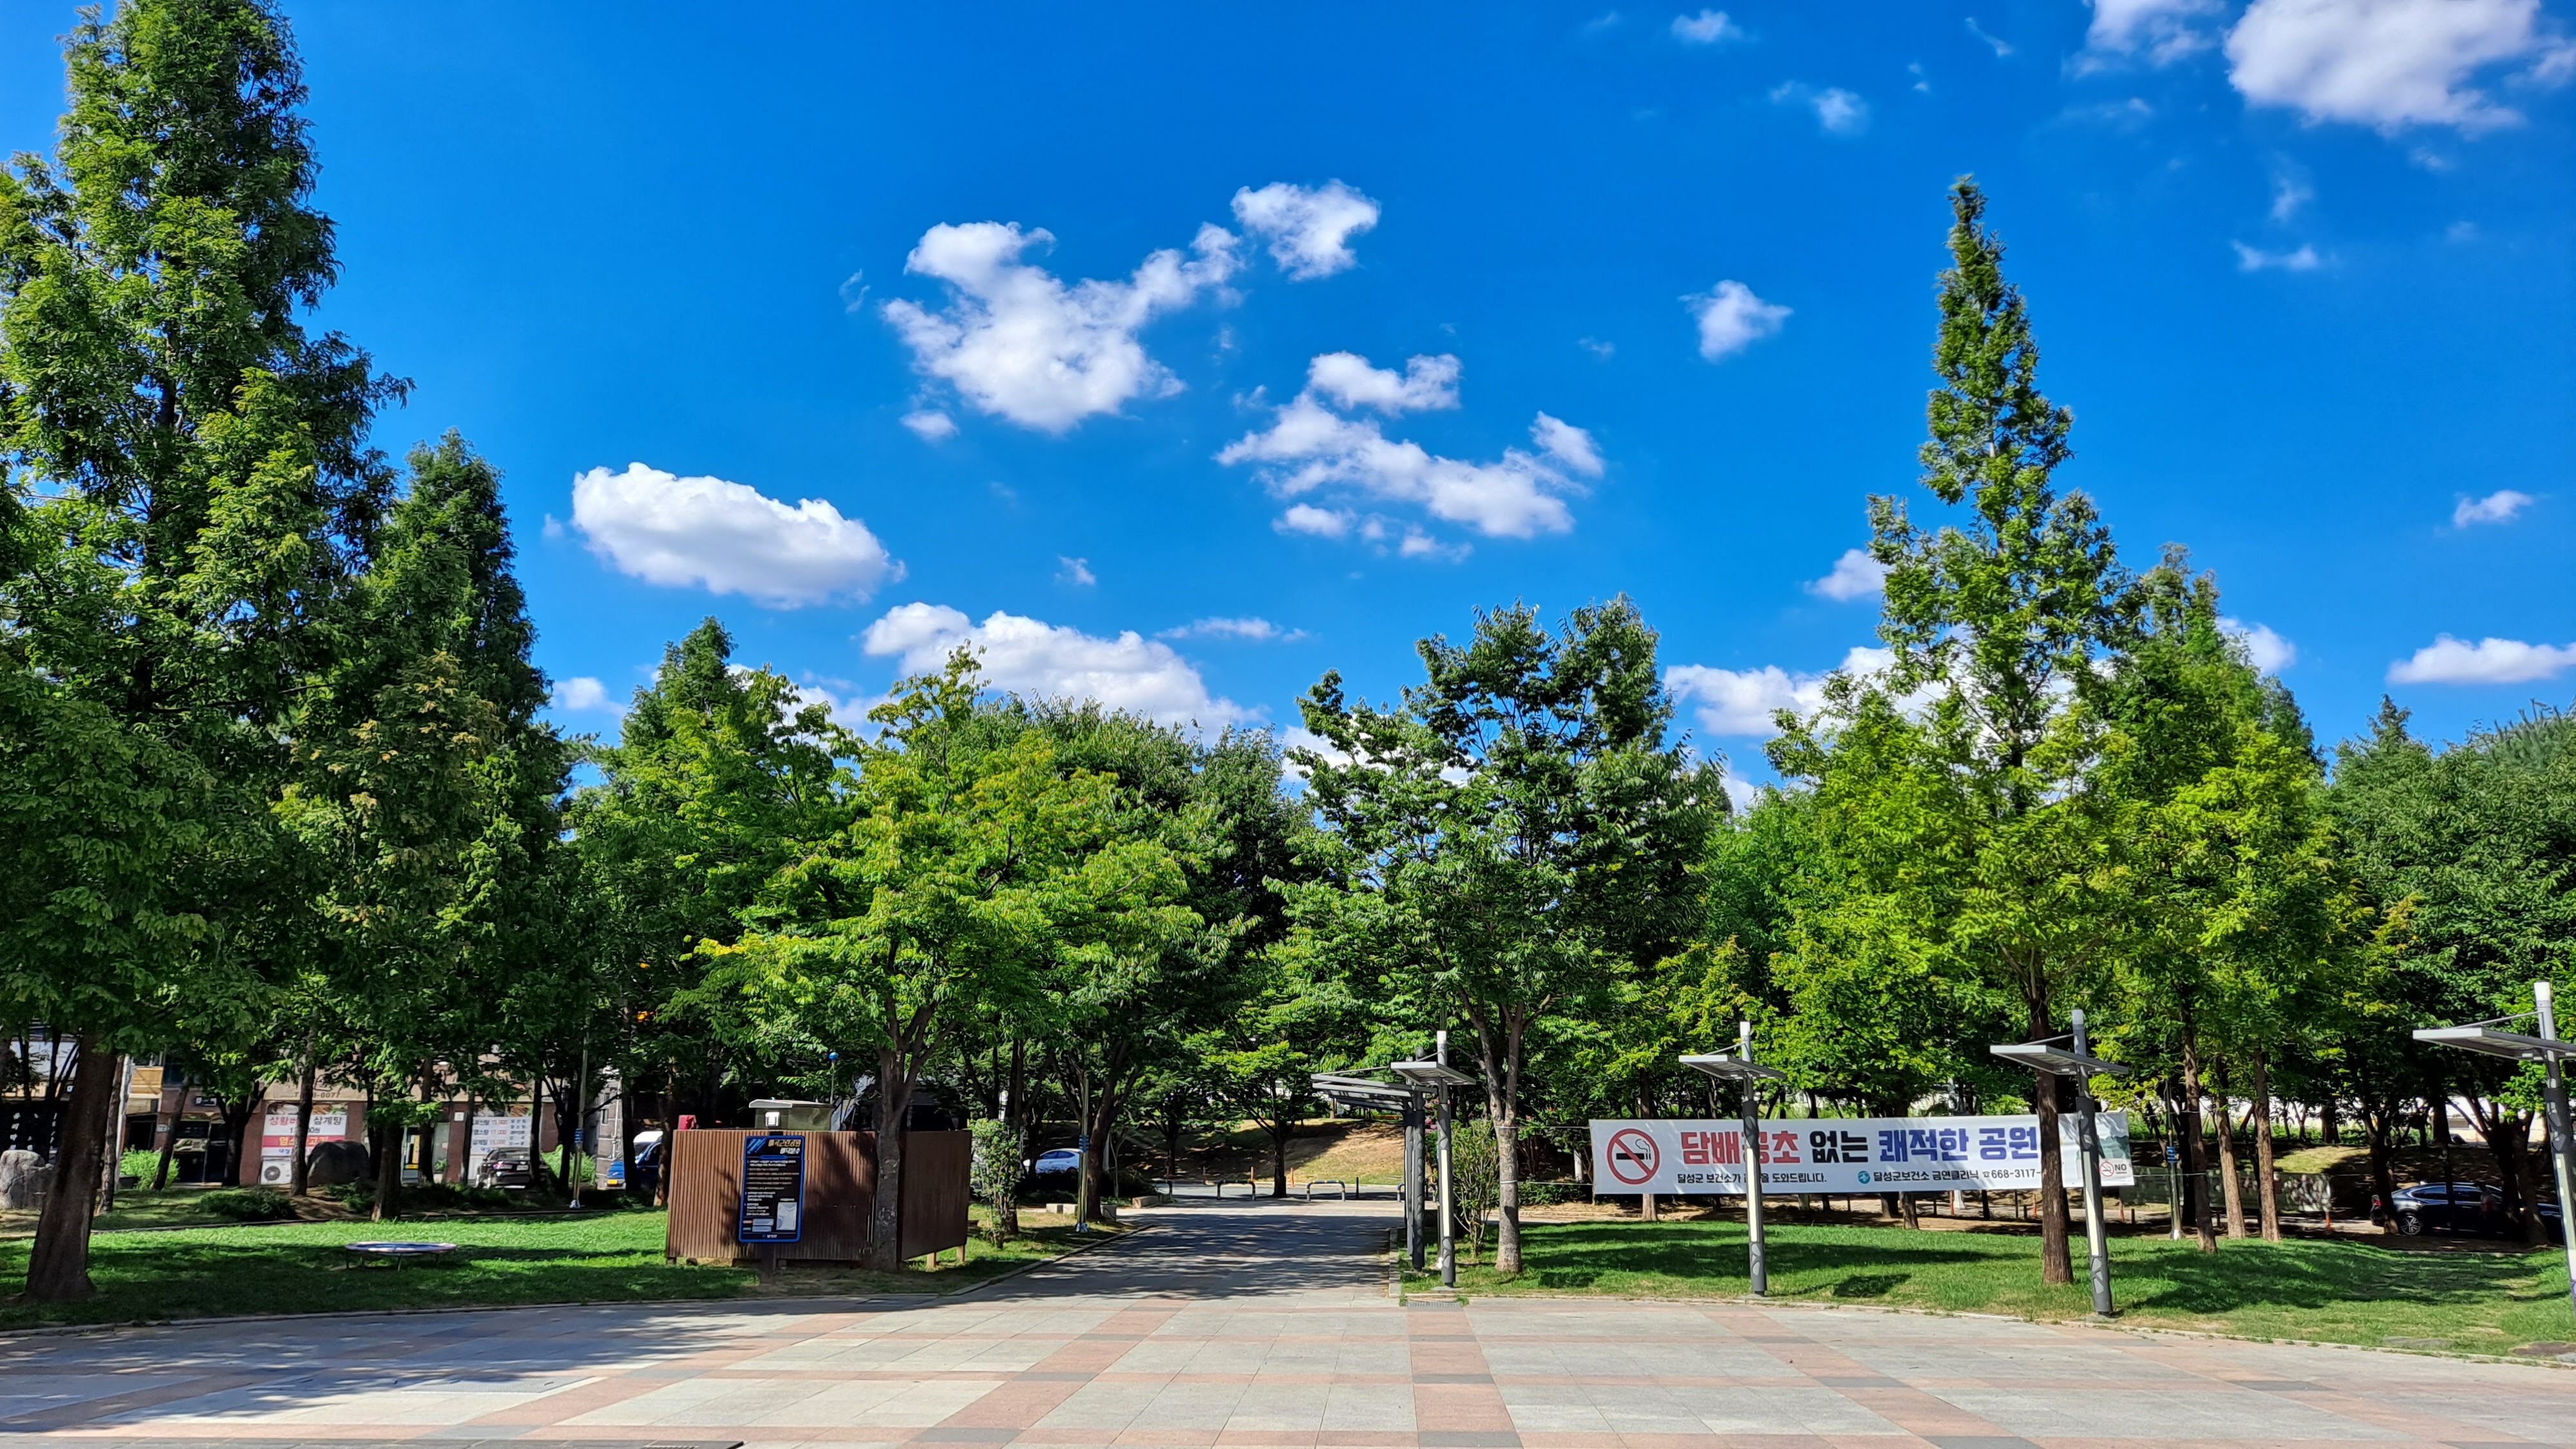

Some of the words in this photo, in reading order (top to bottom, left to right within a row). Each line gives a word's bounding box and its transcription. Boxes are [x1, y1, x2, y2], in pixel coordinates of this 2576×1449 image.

[314, 1116, 342, 1126] 삼계탕
[1810, 1130, 1869, 1163] 없는
[1878, 1128, 1969, 1162] 쾌적한
[1978, 1126, 2038, 1160] 공원
[1677, 1173, 1703, 1184] 달성군
[1706, 1173, 1741, 1184] 보건소가
[1772, 1173, 1827, 1184] 도와드립니다.
[1873, 1171, 1929, 1182] 달성군보건소
[1932, 1170, 1979, 1181] 금연클리닉
